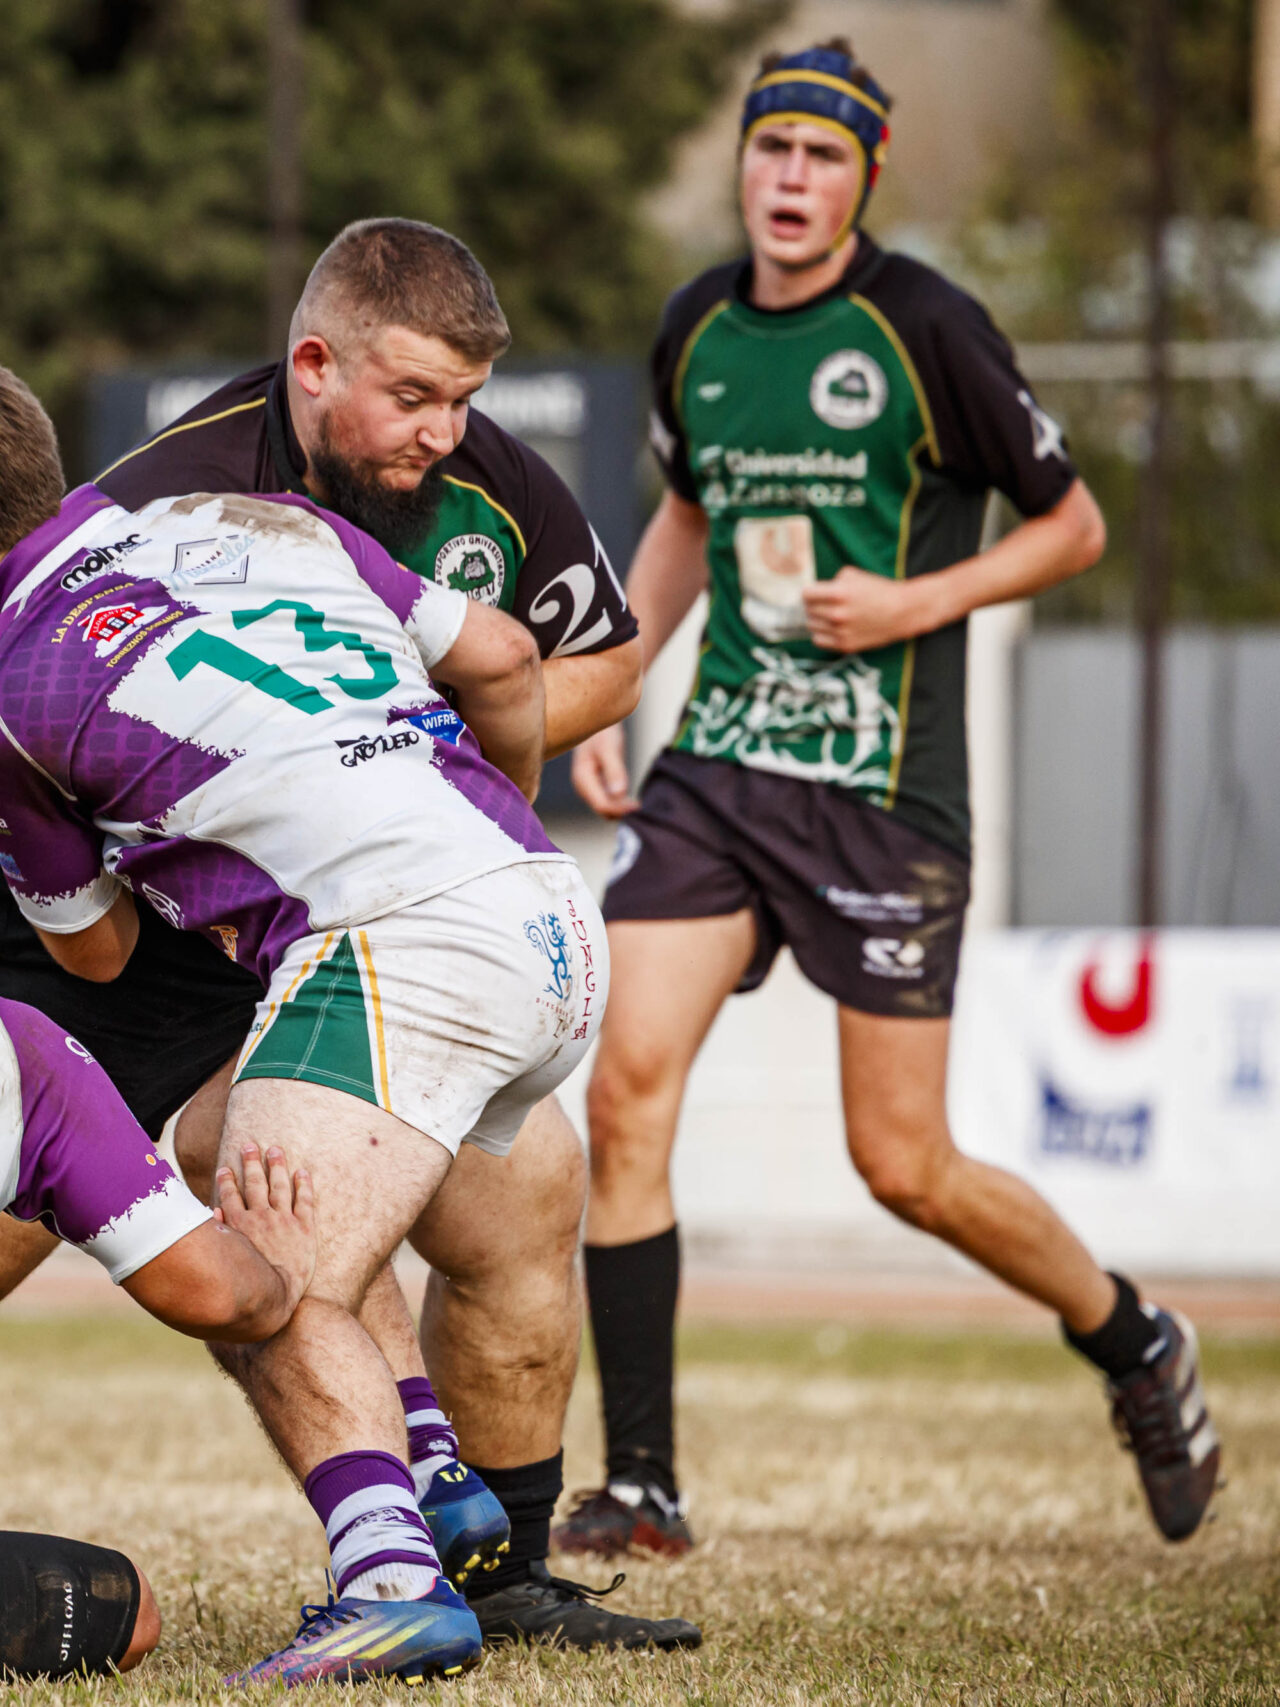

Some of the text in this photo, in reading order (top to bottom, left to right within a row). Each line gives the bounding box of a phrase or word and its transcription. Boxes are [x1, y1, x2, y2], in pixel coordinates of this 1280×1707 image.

[51, 626, 68, 644] LA
[105, 630, 148, 668] TORREZNOS
[166, 599, 400, 715] 13
[422, 713, 458, 730] WIFRE
